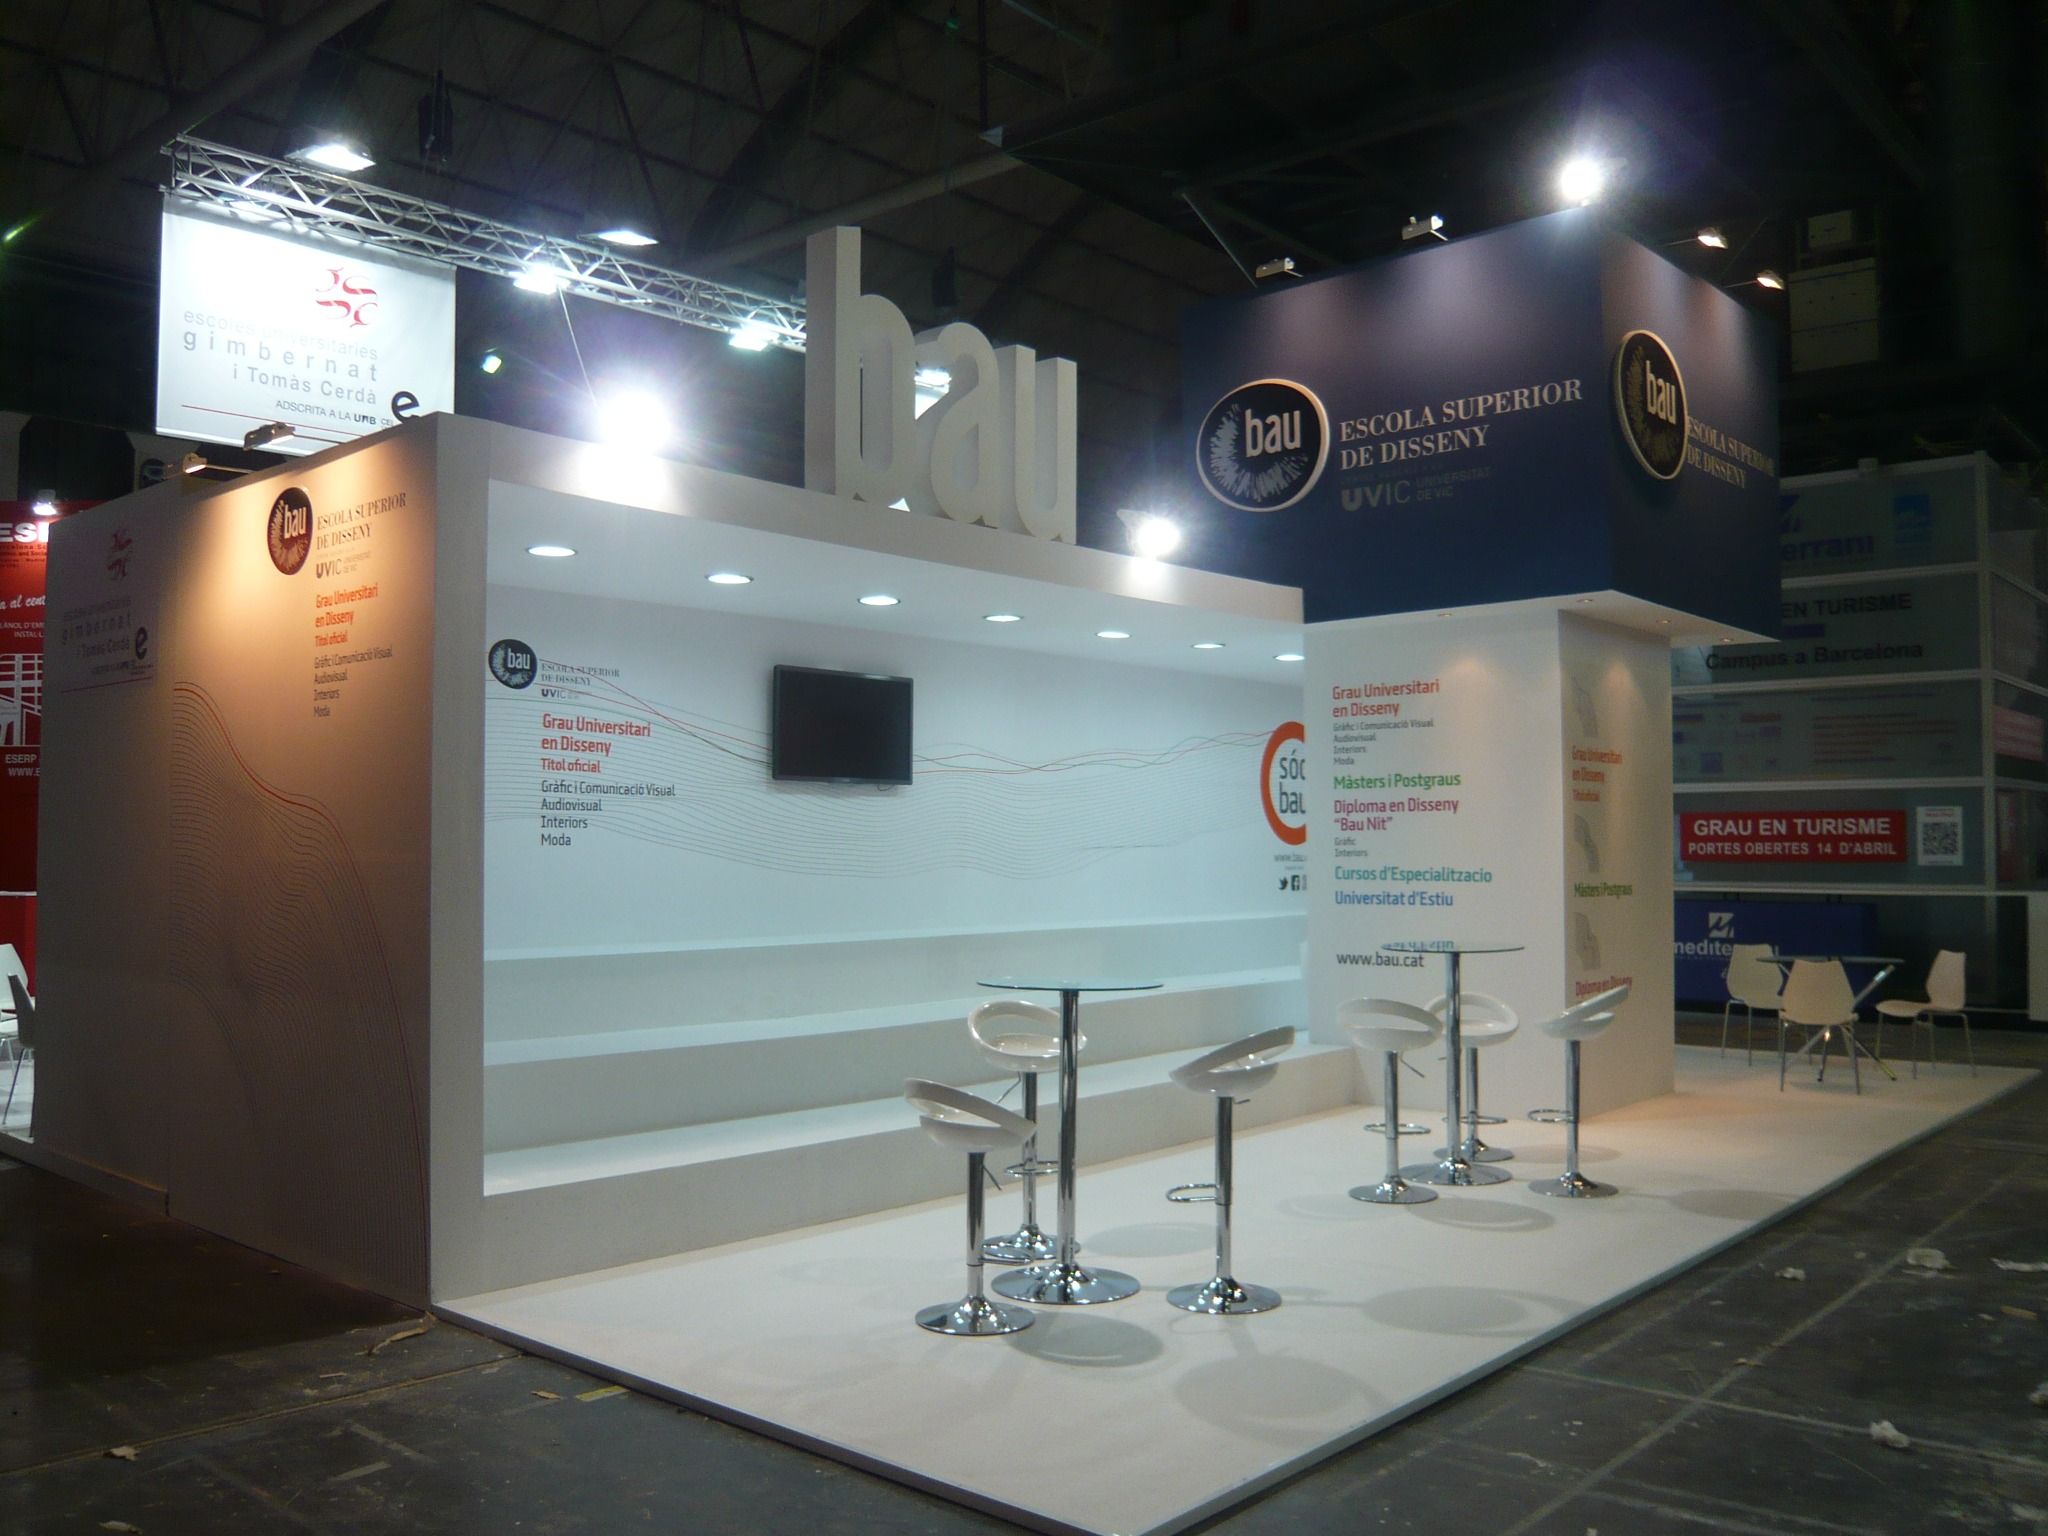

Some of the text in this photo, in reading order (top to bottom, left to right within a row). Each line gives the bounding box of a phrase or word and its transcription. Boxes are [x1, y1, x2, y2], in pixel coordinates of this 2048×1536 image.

[183, 330, 377, 382] gimbernat
[247, 366, 311, 393] Tomàs
[320, 381, 376, 405] Cerdà
[805, 226, 1077, 545] bau
[1646, 360, 1676, 425] bau
[276, 400, 326, 417] ADSCRITA
[329, 410, 336, 418] A
[339, 411, 351, 420] LA
[1340, 379, 1582, 442] ESCOLA SUPERIOR
[1244, 408, 1302, 458] bau
[1340, 424, 1490, 471] DE DISSENY
[1341, 481, 1411, 511] UVIC
[317, 492, 406, 530] ESCOLA SUPERIOR
[284, 504, 307, 539] bau
[316, 523, 372, 550] DE DISSENY
[316, 559, 342, 578] UVIC
[1816, 593, 1913, 616] TURISME
[507, 648, 531, 669] bau
[1705, 643, 1923, 671] Campus a Barcelona
[541, 688, 566, 699] UVIC
[1332, 679, 1440, 700] Grau Universitari
[1332, 702, 1400, 717] en Disseny
[542, 713, 651, 737] Grau Universitari
[1410, 718, 1434, 728] Visual
[541, 735, 611, 757] en Disseny
[1333, 733, 1377, 742] Audiovisual
[5, 754, 37, 763] ESERP
[1333, 746, 1366, 754] Interiors
[567, 758, 601, 773] oficial
[1333, 756, 1355, 765] Moda
[541, 779, 574, 793] Gràfic
[579, 780, 645, 796] Comunicació
[646, 783, 676, 797] Visual
[1333, 773, 1461, 790] Màsters i Postgraus
[541, 798, 602, 812] Audiovisual
[1334, 798, 1459, 815] Diploma en Disseny
[541, 815, 588, 828] Interiors
[1693, 818, 1891, 836] GRAU EN TURISME
[541, 834, 571, 846] Moda
[1688, 842, 1897, 856] PORTES OBERTES 14 D'ABRIL
[1335, 866, 1377, 881] Cursos
[1335, 891, 1454, 906] Universitat d'Estiu
[1336, 951, 1424, 967] www.bau.cat
